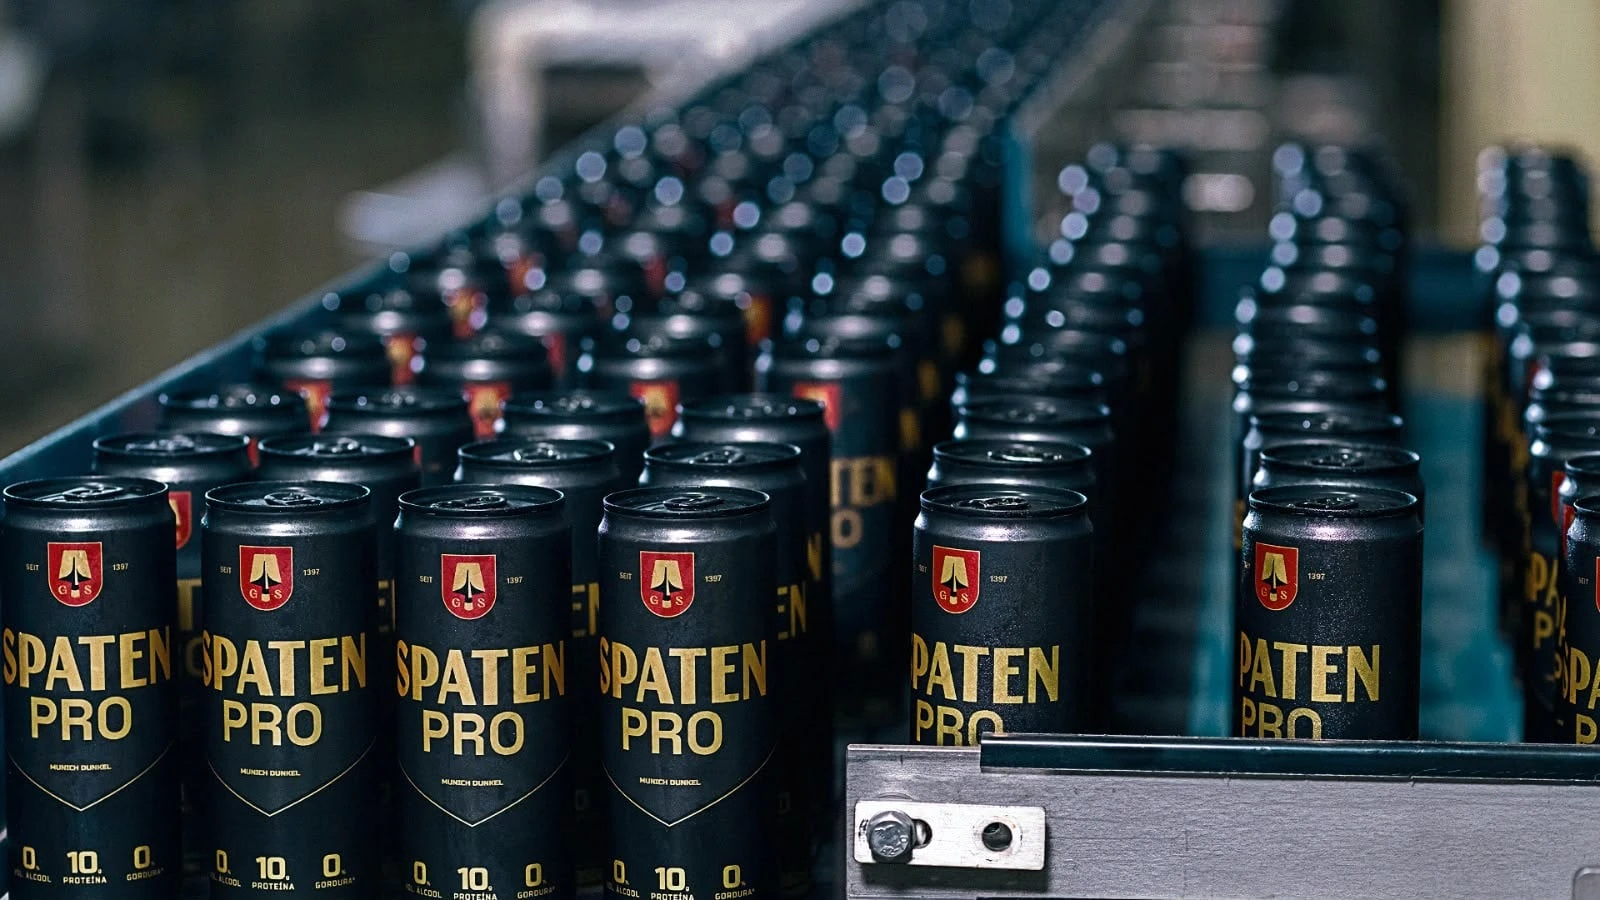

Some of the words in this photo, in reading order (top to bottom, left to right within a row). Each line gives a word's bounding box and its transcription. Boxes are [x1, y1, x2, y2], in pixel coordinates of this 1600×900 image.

[303, 568, 319, 576] 1397
[507, 576, 523, 584] 1397
[58, 585, 67, 594] G
[84, 585, 92, 594] S
[249, 589, 257, 598] G
[274, 590, 282, 599] S
[452, 598, 460, 607] G
[477, 598, 485, 608] S
[650, 596, 658, 604] G
[675, 596, 683, 605] S
[940, 591, 946, 600] G
[961, 593, 968, 603] S
[1280, 591, 1287, 599] S
[4, 628, 169, 691] SPATEN
[203, 631, 365, 696] SPATEN
[397, 640, 564, 705] SPATEN
[600, 637, 766, 704] SPATEN
[912, 633, 1059, 704] PATEN
[1240, 631, 1380, 703] PATEN
[31, 696, 131, 740] PRO
[224, 700, 321, 746] PRO
[622, 707, 722, 755] PRO
[423, 710, 524, 755] PRO
[241, 768, 268, 776] MUNICH
[640, 777, 668, 785] MUNICH
